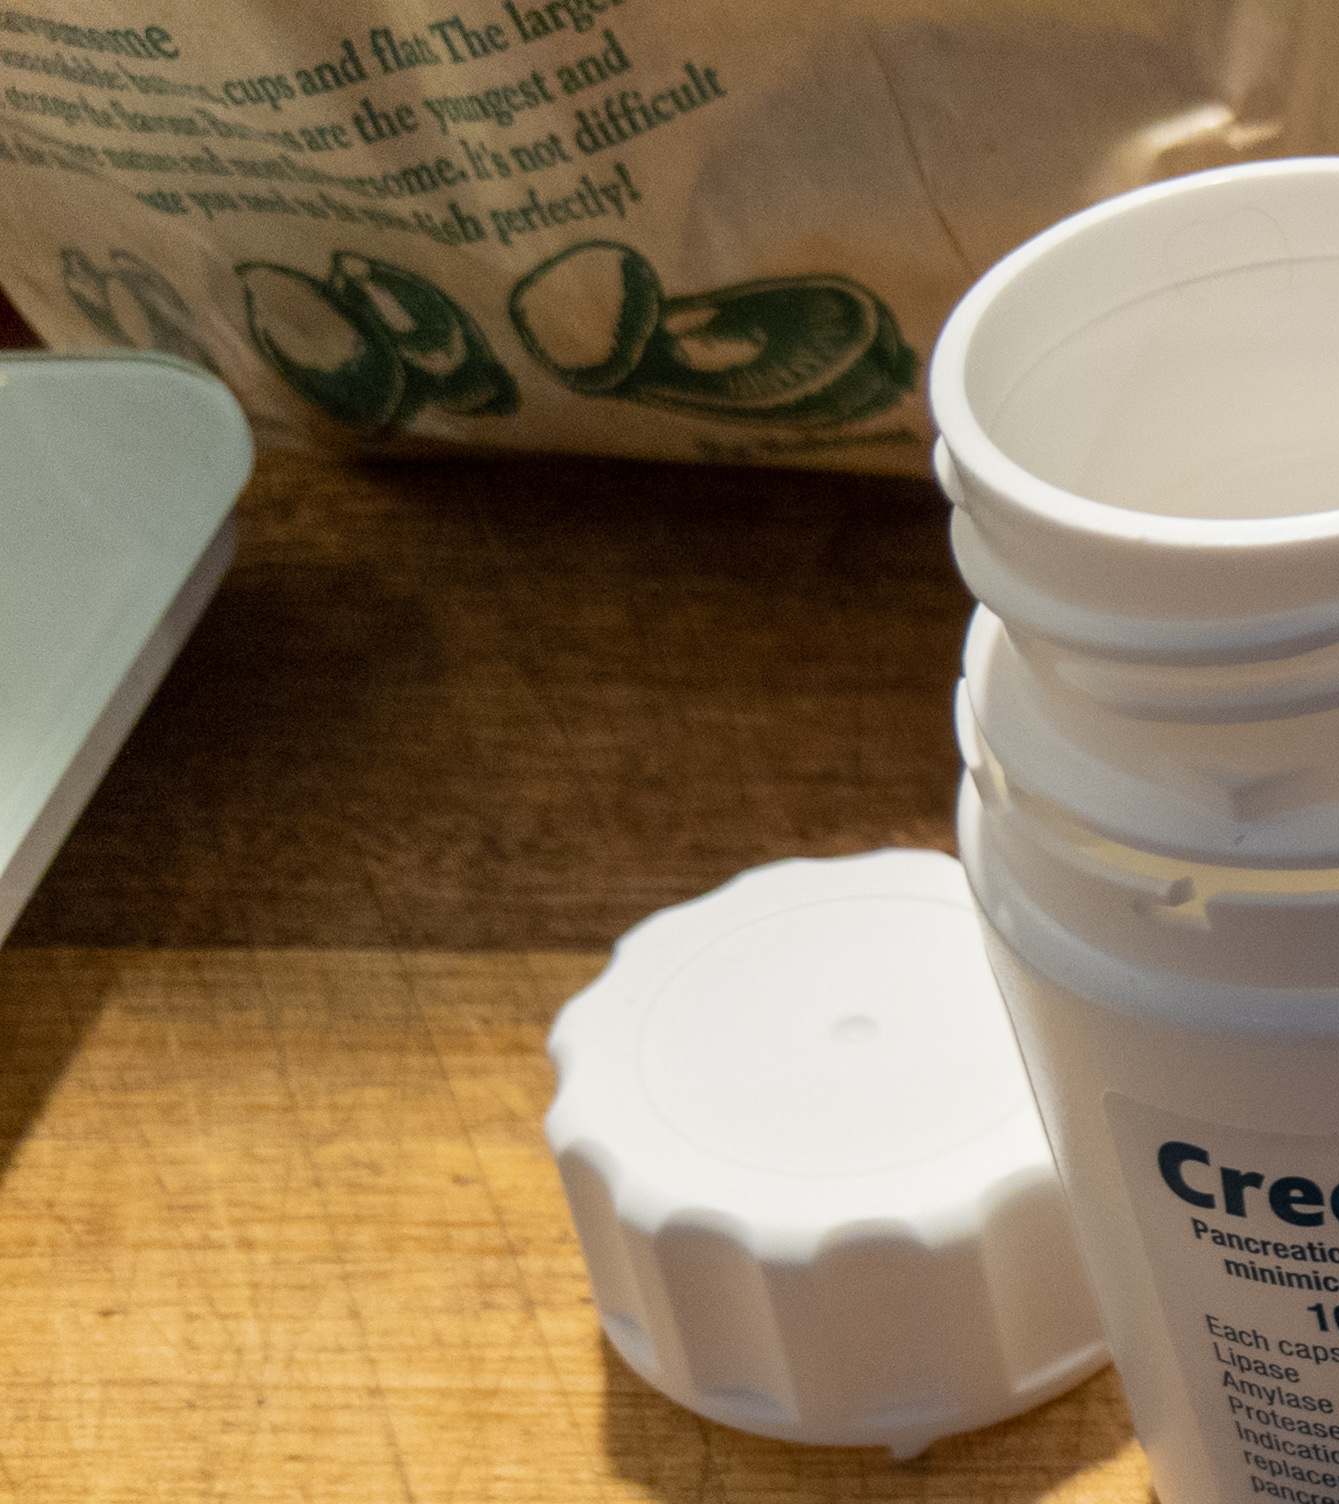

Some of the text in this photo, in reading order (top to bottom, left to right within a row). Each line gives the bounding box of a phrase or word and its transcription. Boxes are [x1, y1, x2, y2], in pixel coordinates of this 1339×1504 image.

[223, 73, 296, 112] cups
[296, 38, 368, 97] and
[428, 14, 510, 64] The
[299, 123, 350, 153] are
[353, 97, 419, 146] the
[424, 70, 555, 135] youngest
[555, 28, 632, 96] and
[510, 133, 573, 174] not
[574, 61, 727, 156] difficult
[490, 162, 642, 246] perfectly!
[1205, 1313, 1270, 1352] Each
[1213, 1341, 1301, 1384] Lipase
[1222, 1369, 1335, 1415] Amylase
